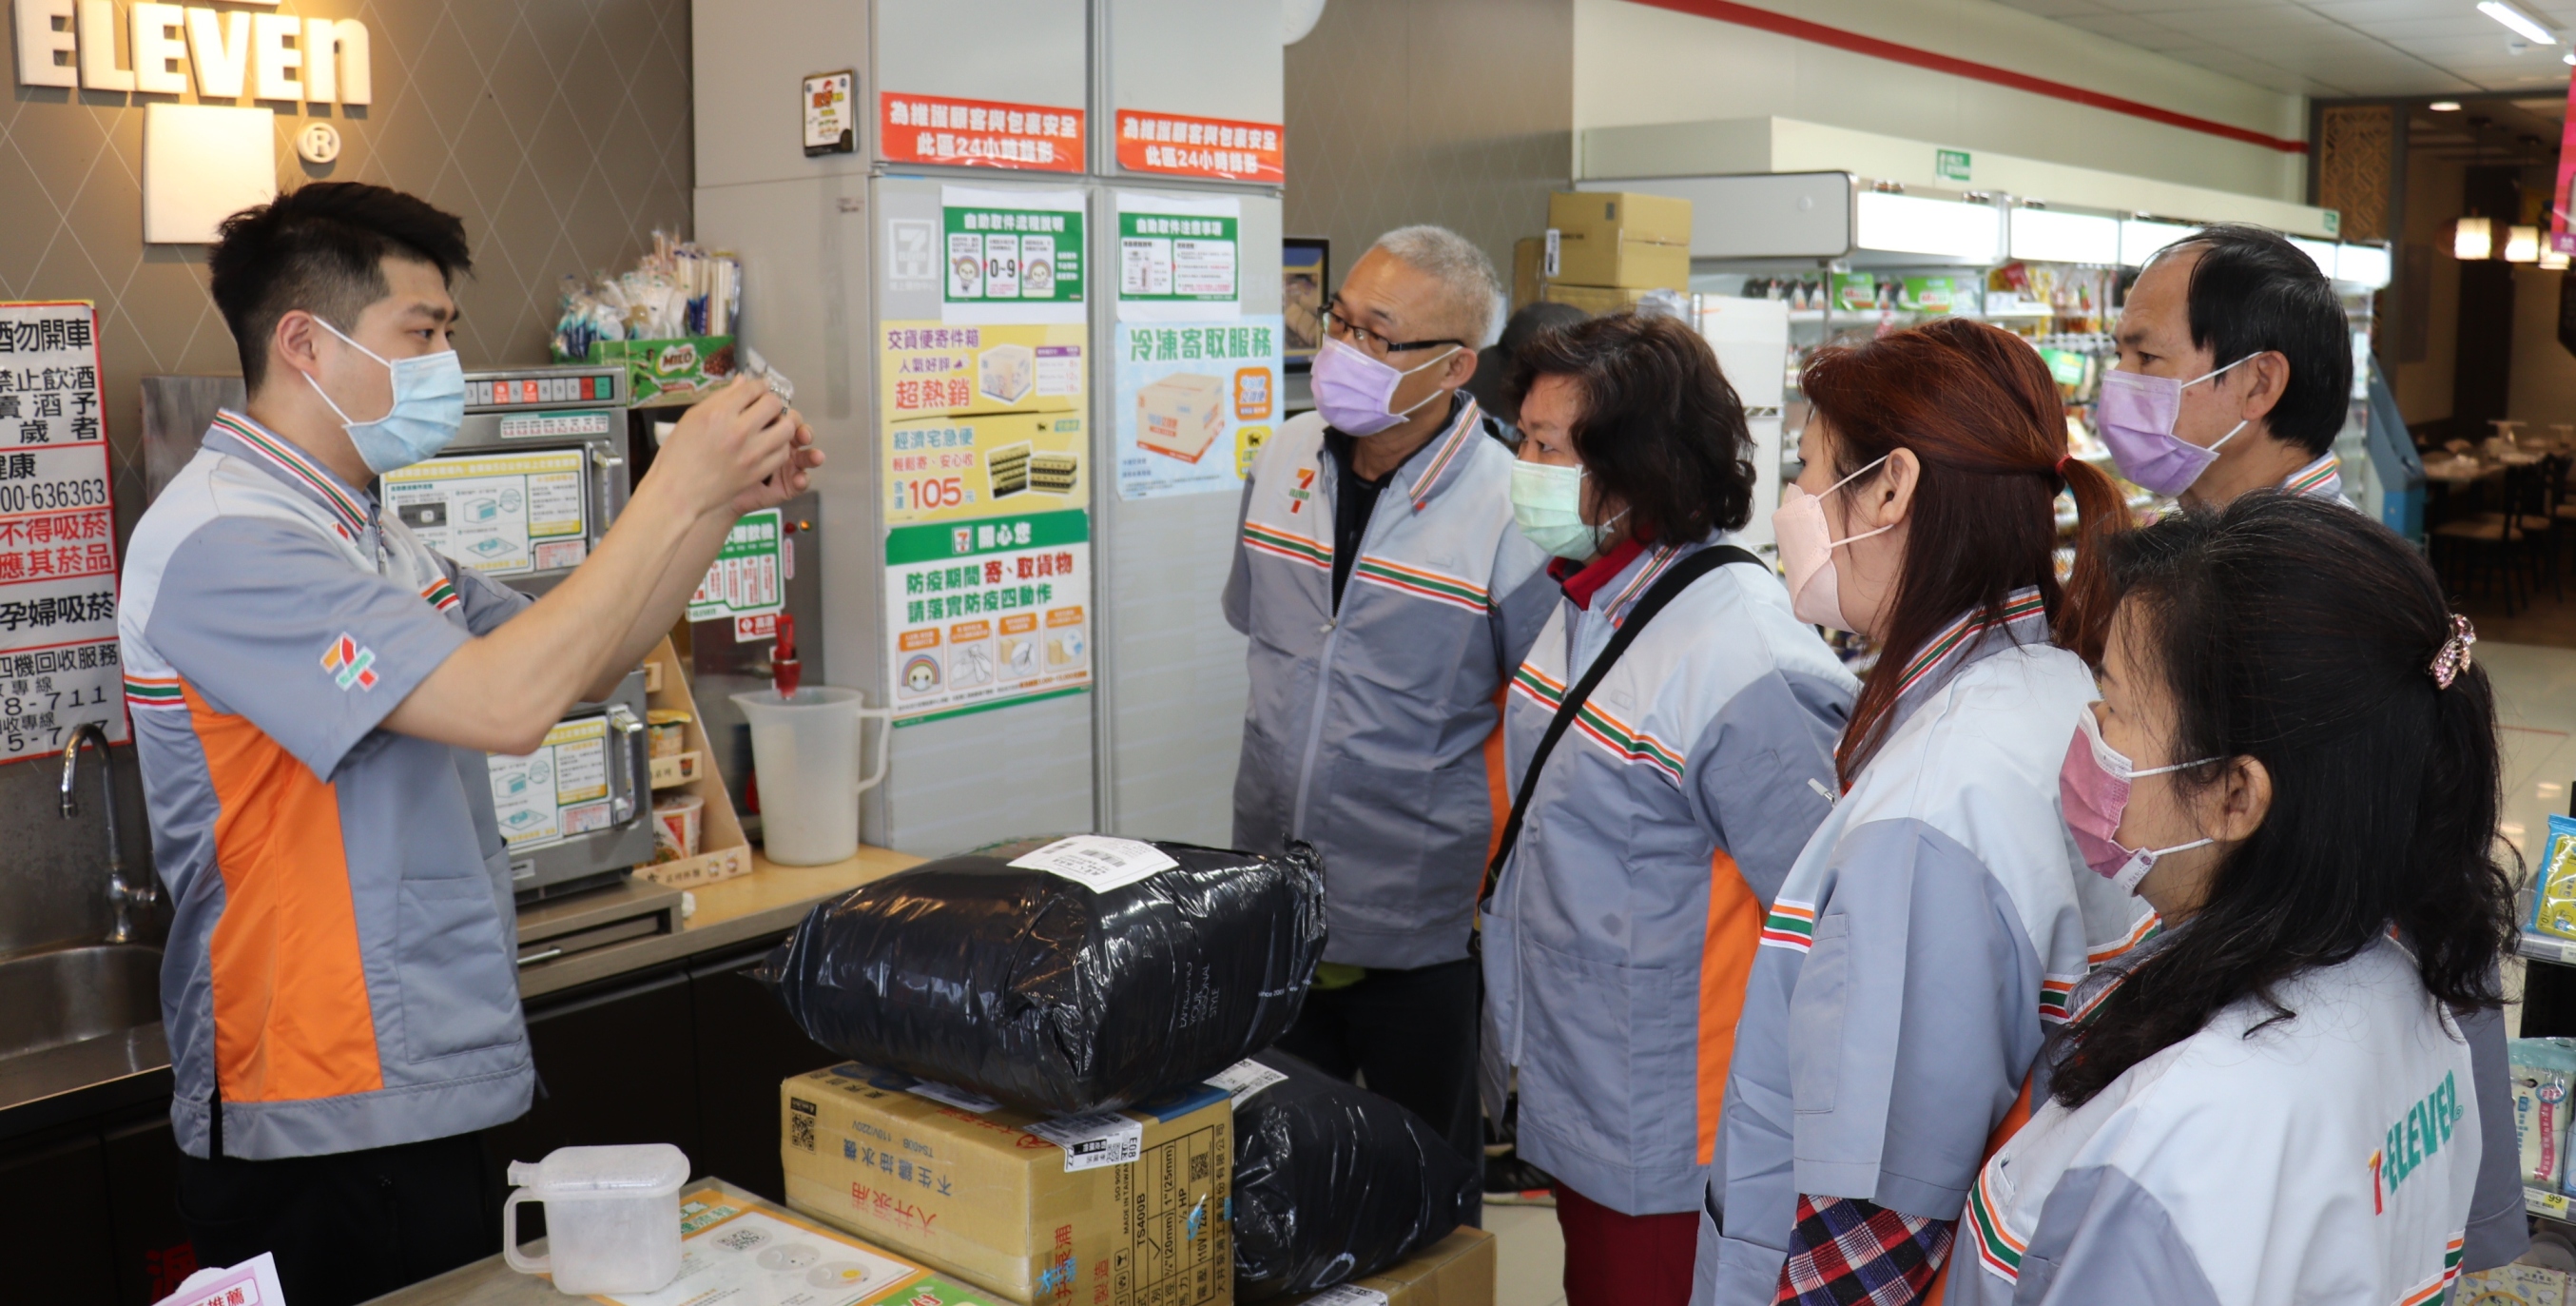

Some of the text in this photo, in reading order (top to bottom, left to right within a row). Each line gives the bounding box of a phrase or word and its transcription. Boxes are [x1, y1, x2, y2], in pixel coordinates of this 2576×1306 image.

[889, 100, 1077, 139] 為維護顧客與包裹安全
[887, 328, 979, 350] 交貨便寄件箱
[1130, 326, 1272, 361] 冷凍寄取服務
[663, 351, 693, 367] MILO
[898, 357, 951, 374] 人氣好評
[895, 379, 970, 410] 超熱銷
[893, 427, 974, 451] 經濟宅急便
[0, 453, 36, 480] 康
[1, 478, 106, 512] 00-636363
[909, 477, 962, 510] 105
[0, 511, 107, 547] 不得吸菸
[978, 521, 1032, 550] 關心您
[0, 543, 111, 579] 應其菸品
[0, 591, 115, 632] 孕婦吸菸
[907, 583, 1053, 624] 請落實防疫四動作
[0, 675, 53, 698] 專線
[0, 711, 56, 734] 收專線
[1178, 1187, 1188, 1208] HP
[2547, 1193, 2563, 1204] 99
[1135, 1193, 1147, 1248] TS400B
